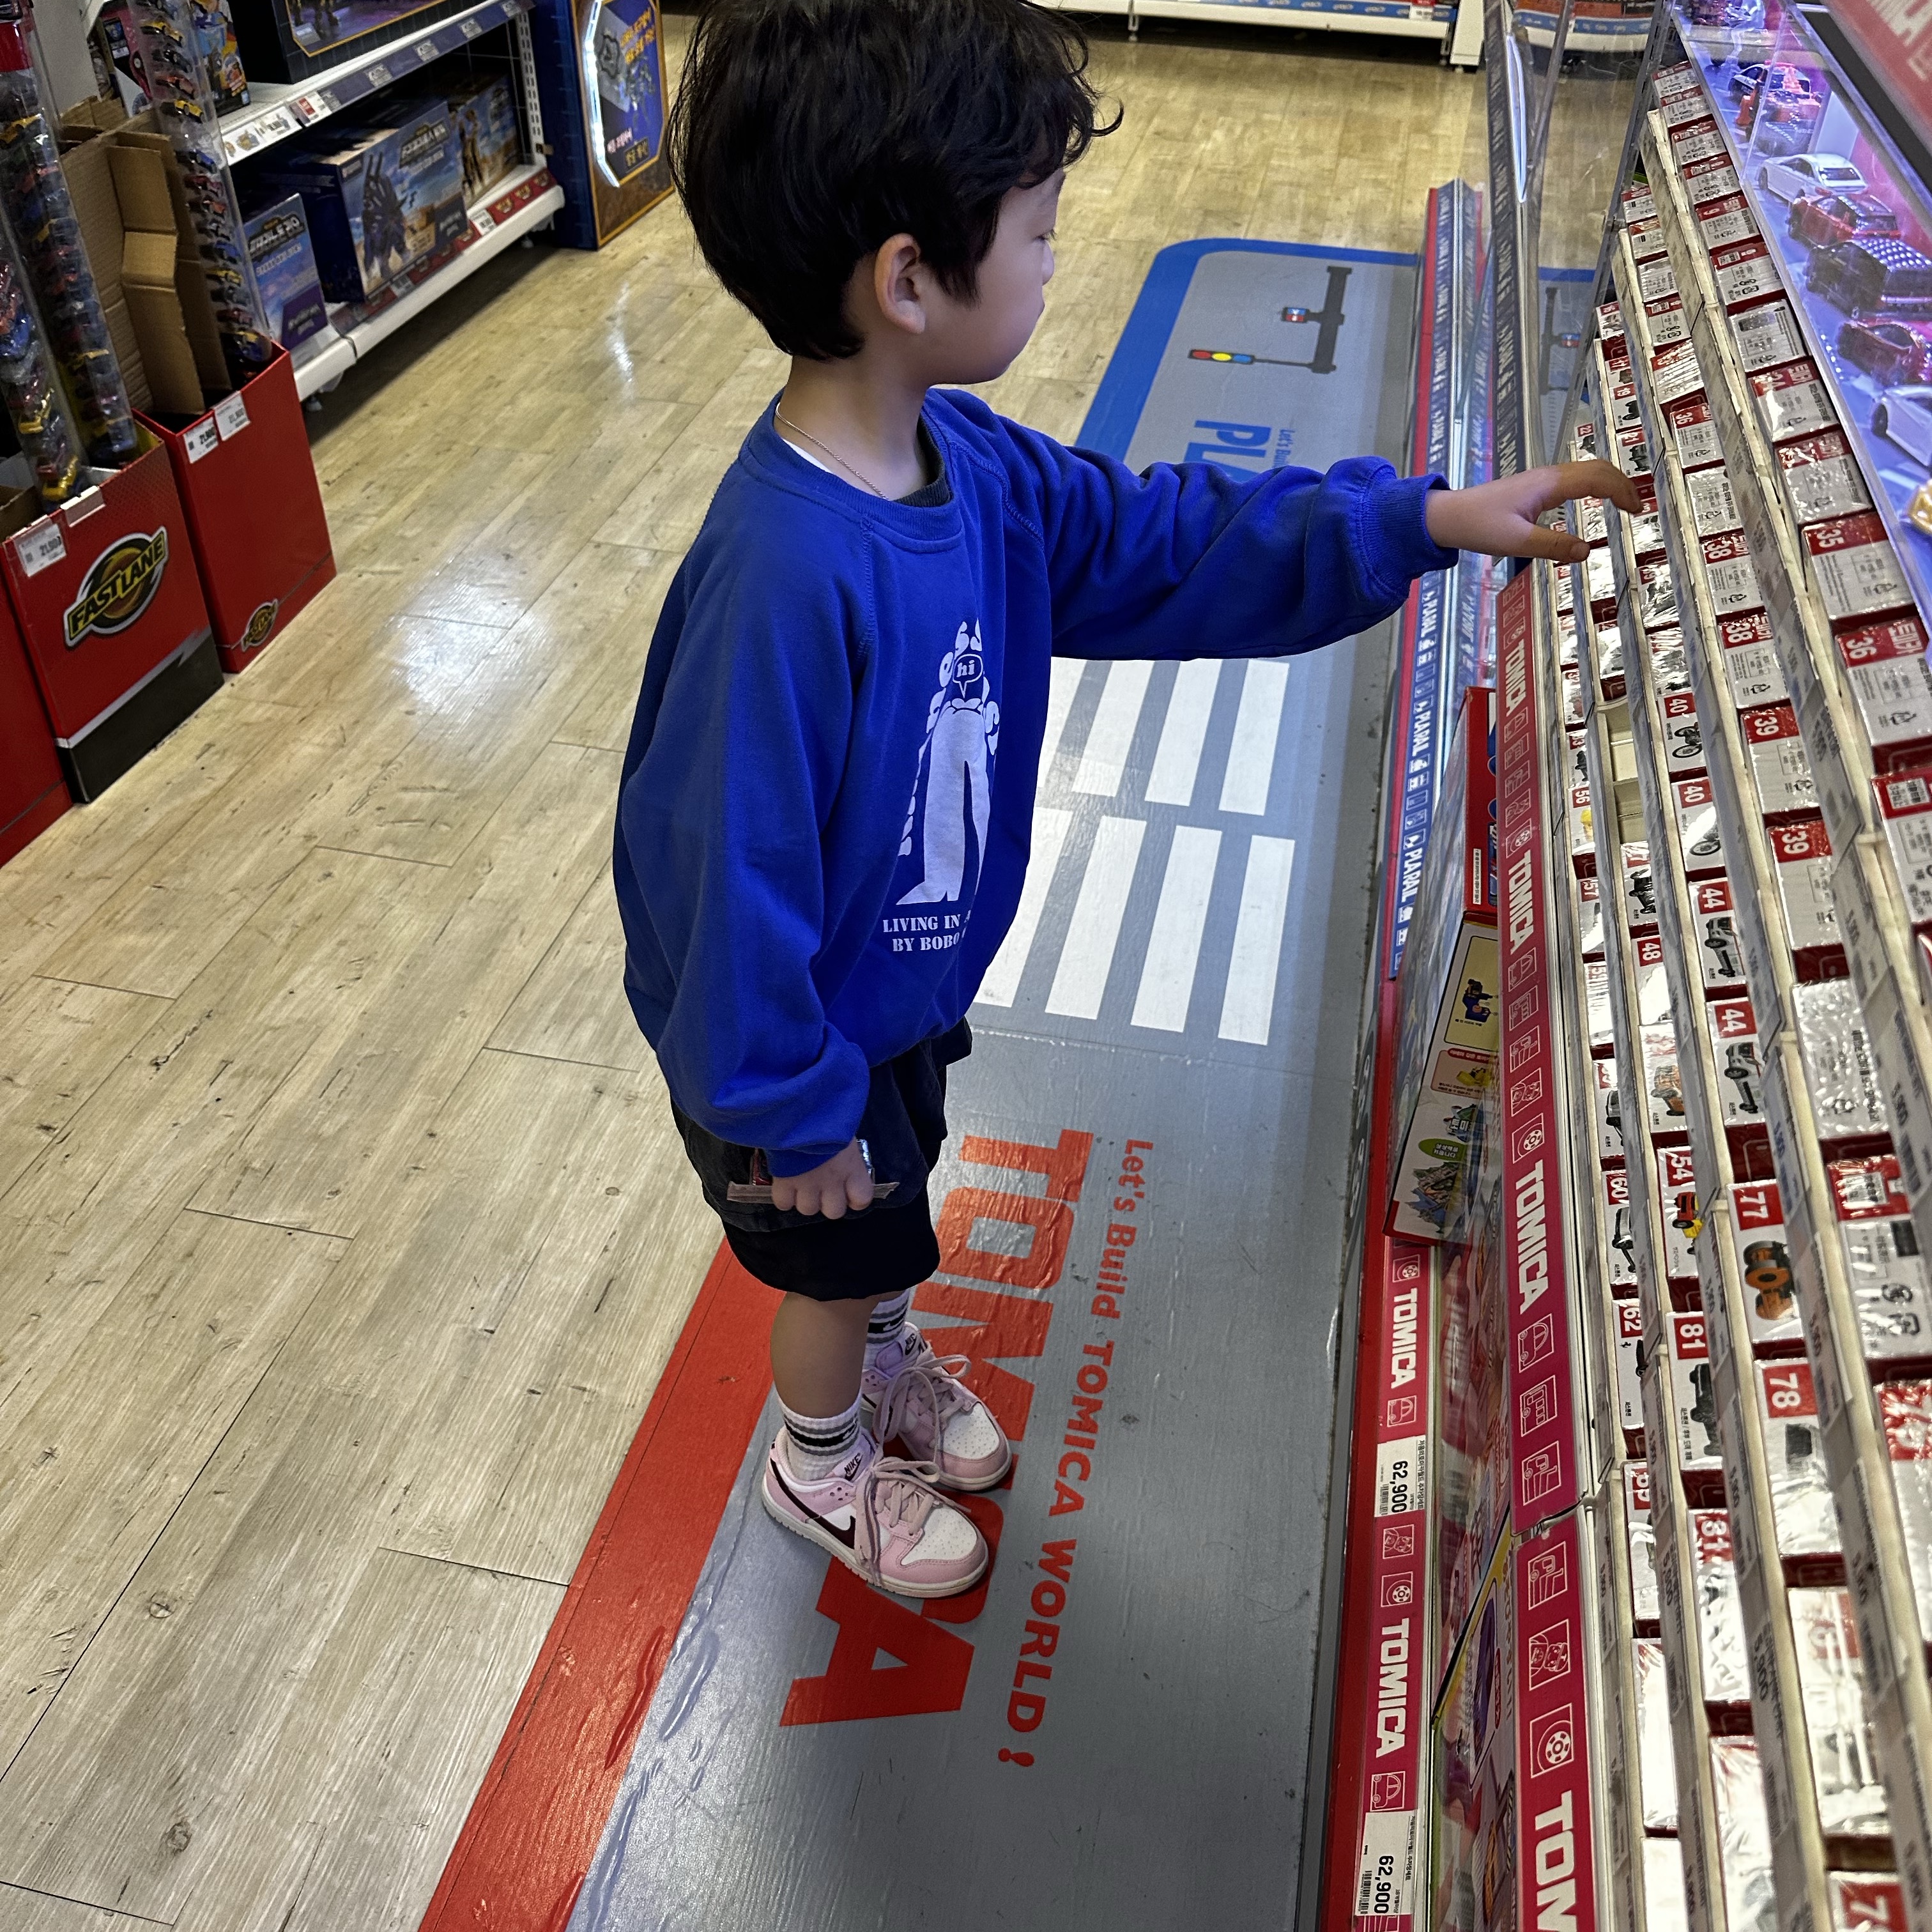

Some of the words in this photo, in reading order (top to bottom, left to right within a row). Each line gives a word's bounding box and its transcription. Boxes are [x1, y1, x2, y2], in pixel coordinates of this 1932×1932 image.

[1617, 387, 1631, 397] 19
[1580, 425, 1592, 435] 22
[1675, 412, 1694, 425] 36
[1625, 432, 1639, 444] 21
[1706, 540, 1732, 559] 38
[1816, 528, 1844, 548] 35
[1726, 622, 1753, 643] 38
[1846, 636, 1878, 659] 36
[956, 659, 976, 677] hi
[1505, 639, 1527, 716] TOMICA
[1669, 698, 1689, 714] 40
[1413, 709, 1429, 758] PLARAIL
[1754, 715, 1780, 737] 39
[1574, 789, 1590, 804] 56
[1683, 785, 1705, 803] 40
[1781, 831, 1811, 855] 39
[1402, 847, 1423, 903] PLARAIL
[1583, 880, 1598, 897] 57
[1702, 887, 1726, 909] 44
[1507, 850, 1534, 954] TOMICA
[883, 916, 939, 933] LIVING
[944, 914, 961, 929] IN
[893, 937, 917, 952] BY
[1641, 942, 1662, 962] 48
[1721, 1008, 1747, 1034] 44
[1114, 1138, 1153, 1215] Let's
[1671, 1155, 1694, 1180] 54
[1611, 1177, 1629, 1199] 60
[1740, 1192, 1769, 1219] 77
[1516, 1159, 1549, 1315] TOMICA
[1091, 1223, 1137, 1319] Build
[1623, 1307, 1643, 1332] 62
[1392, 1288, 1418, 1389] TOMICA
[1680, 1322, 1706, 1349] 81
[1769, 1372, 1802, 1409] 78
[1048, 1340, 1114, 1518] TOMICA
[844, 1453, 860, 1475] NIKE
[1392, 1460, 1409, 1514] 62,900
[1701, 1520, 1730, 1551] 81
[1662, 1551, 1674, 1606] 5,900
[1376, 1618, 1410, 1758] TOMICA
[1374, 1855, 1395, 1914] 62,900
